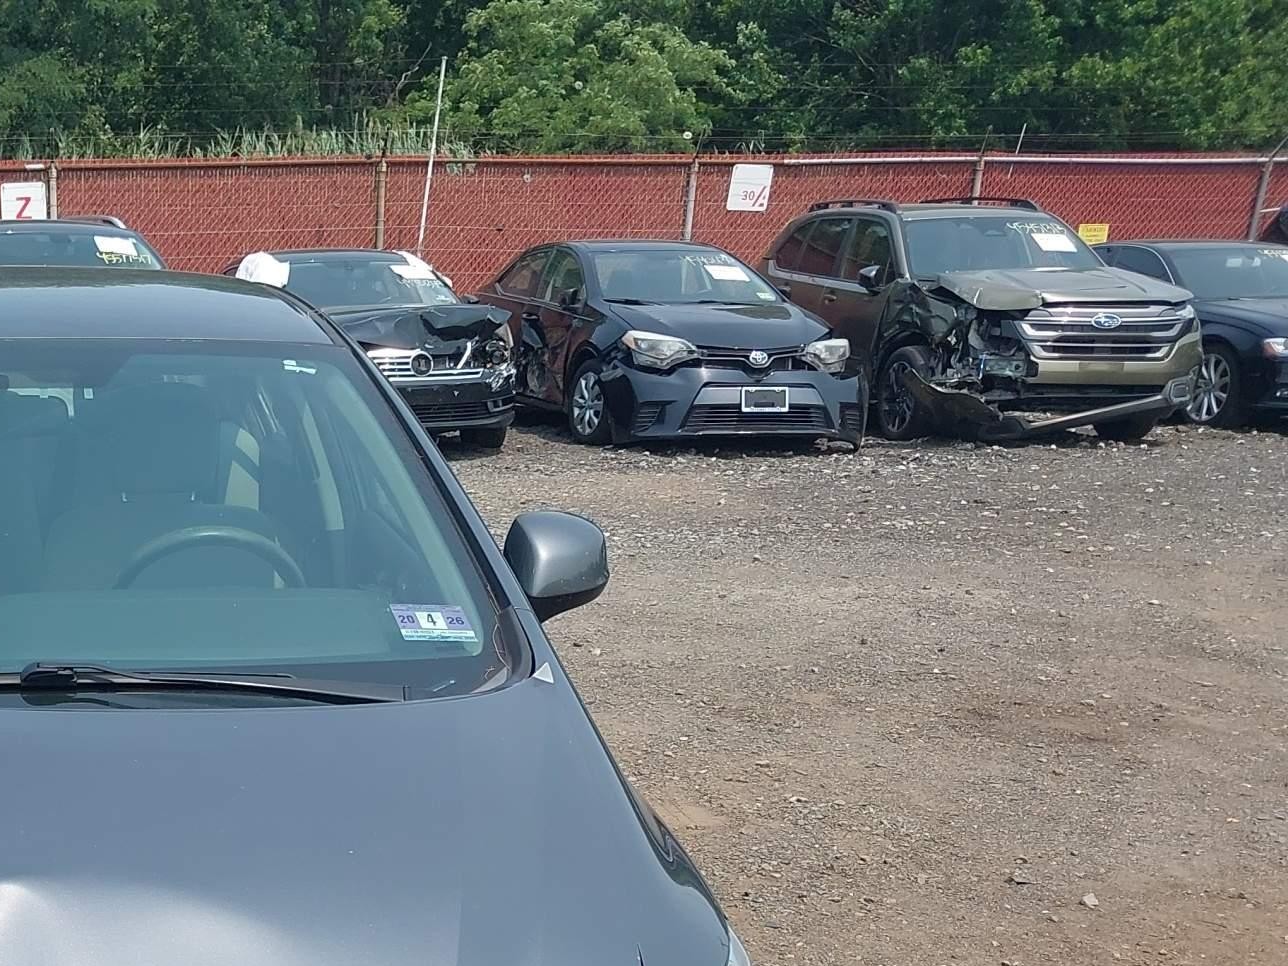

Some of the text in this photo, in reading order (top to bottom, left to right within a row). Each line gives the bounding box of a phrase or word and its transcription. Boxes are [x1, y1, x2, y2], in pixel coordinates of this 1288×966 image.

[15, 196, 33, 219] Z
[398, 613, 465, 627] 20 4 26
